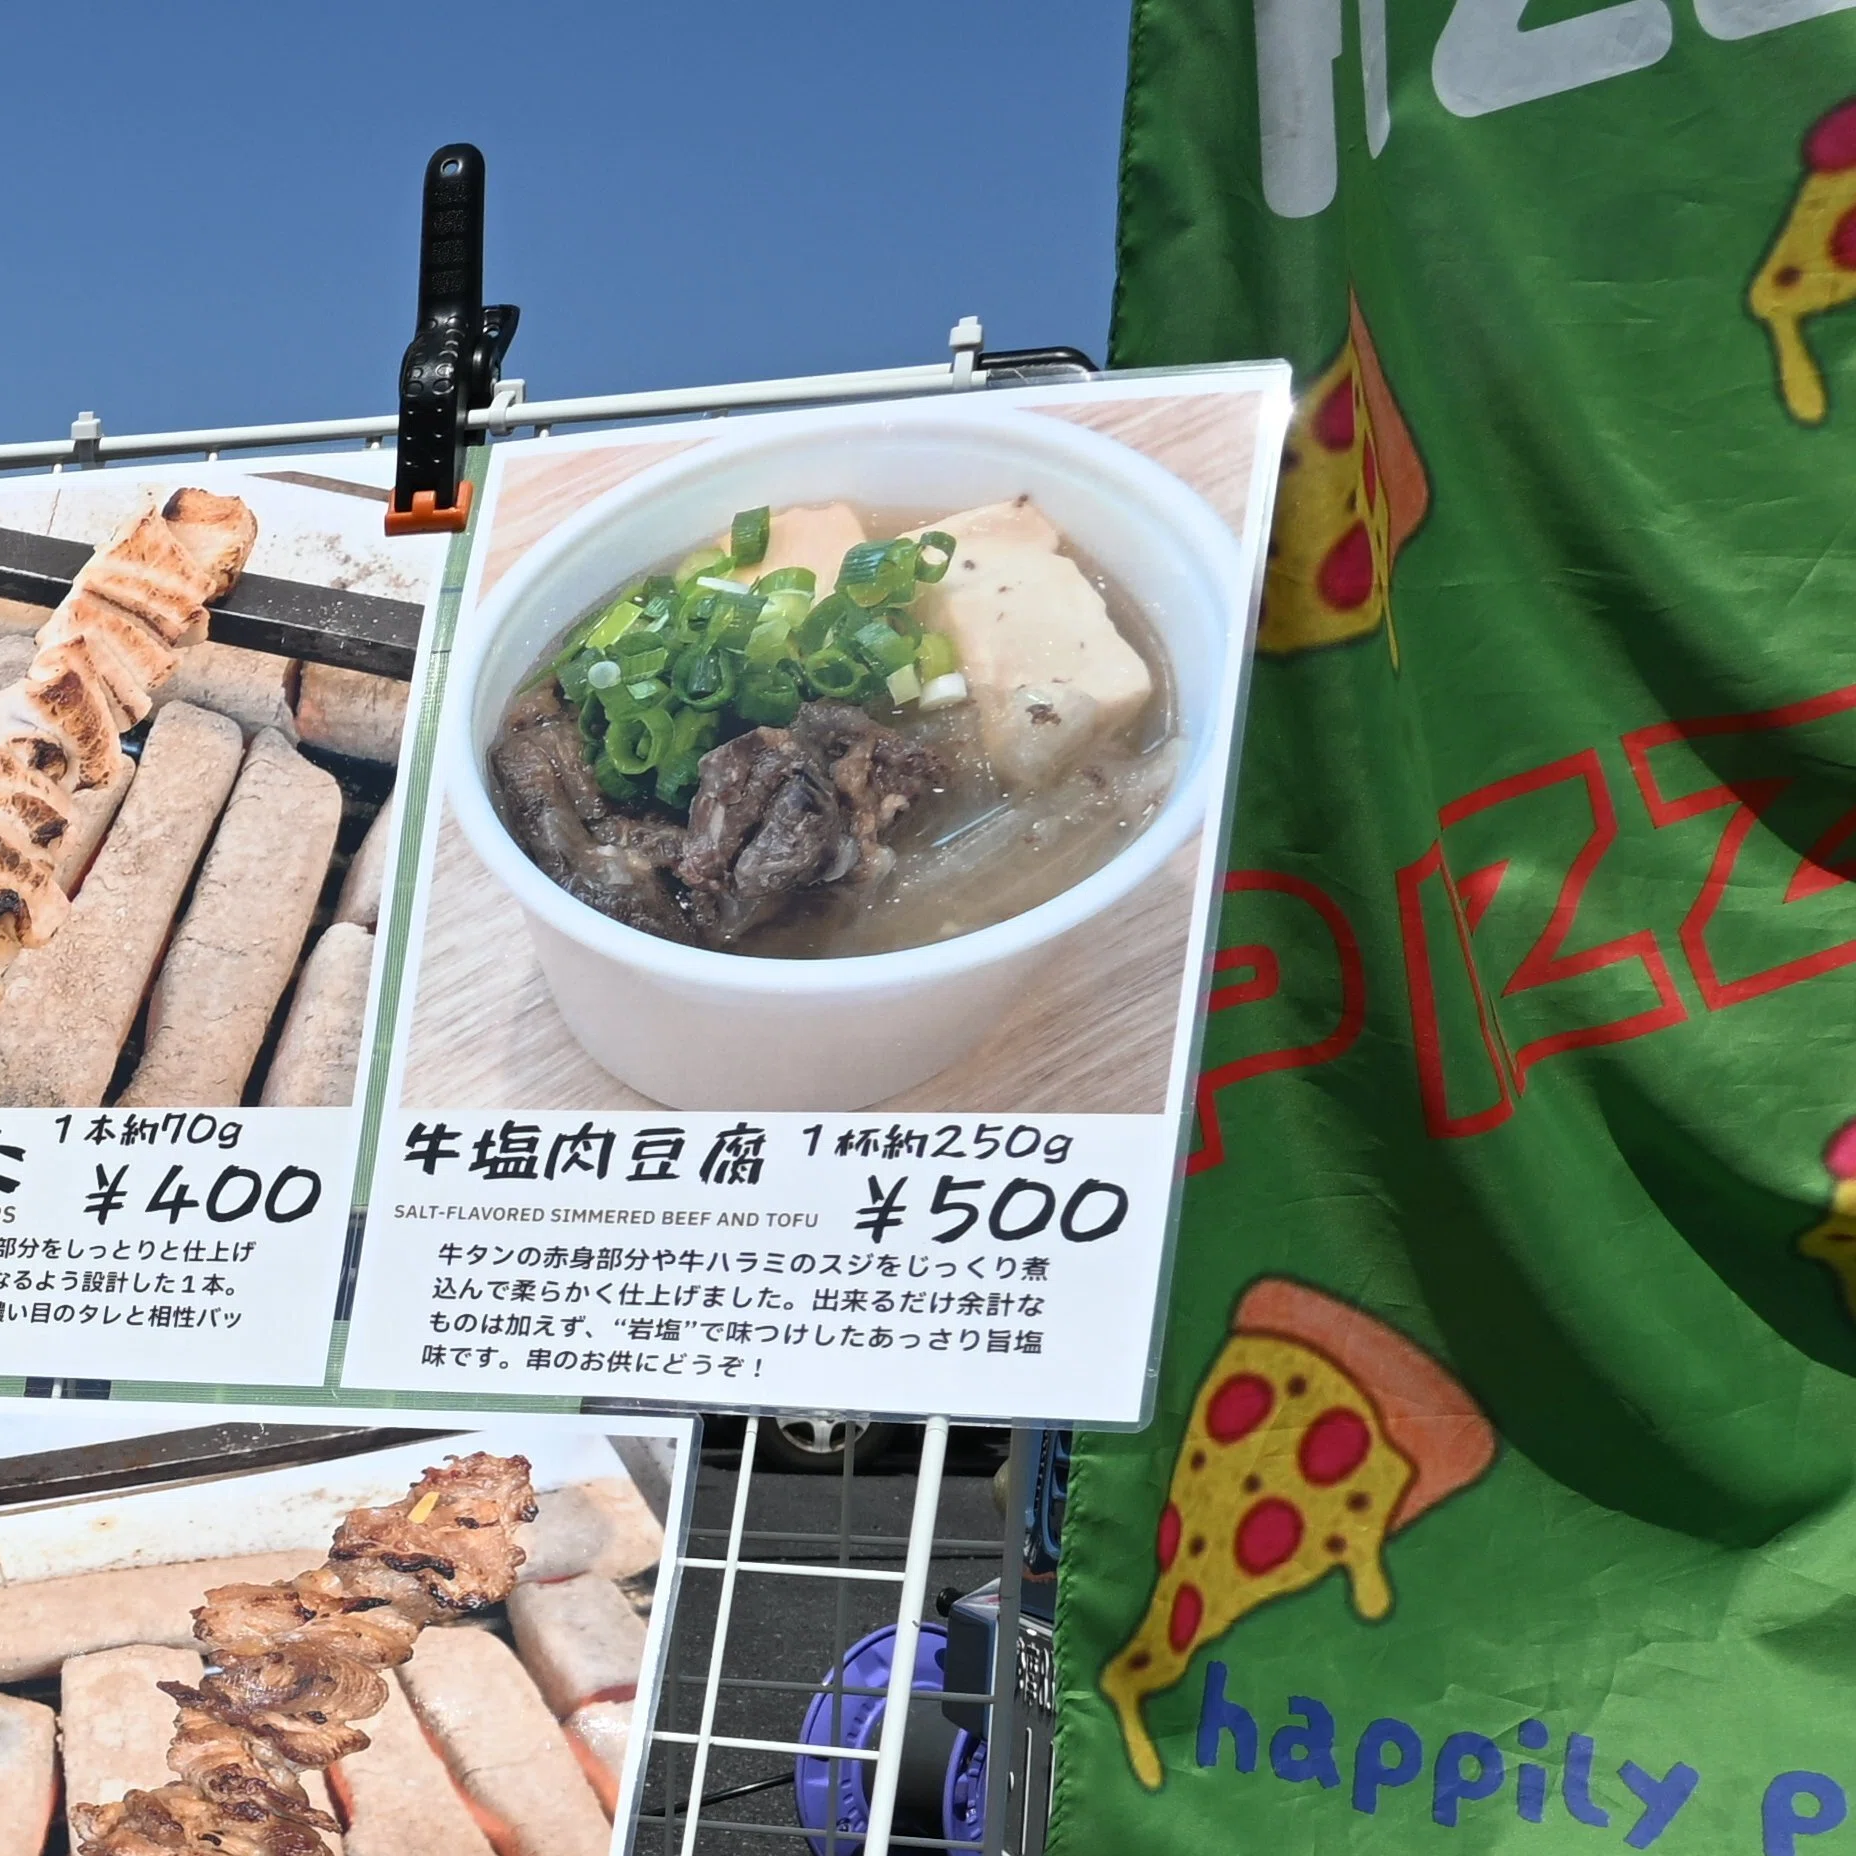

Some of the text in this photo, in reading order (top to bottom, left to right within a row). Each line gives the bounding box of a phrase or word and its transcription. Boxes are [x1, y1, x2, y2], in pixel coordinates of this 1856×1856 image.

[54, 1112, 244, 1150] 1本約70g
[802, 1123, 1074, 1165] 1杯約250g
[403, 1119, 767, 1186] 牛塩肉豆腐
[83, 1162, 322, 1226] ¥400
[853, 1174, 1129, 1245] ¥500
[394, 1204, 818, 1228] SALT-FLAVORED SIMMERED BEEF AND TOFU
[438, 1242, 1051, 1282] 牛タンの赤身部分や牛ハラミのスジをじっくり煮
[431, 1276, 1045, 1317] 込んで柔らかく仕上げました。出来るだけ余計な
[421, 1343, 762, 1378] 味です。串のお供にどうぞ！
[1196, 1661, 1699, 1849] happily
